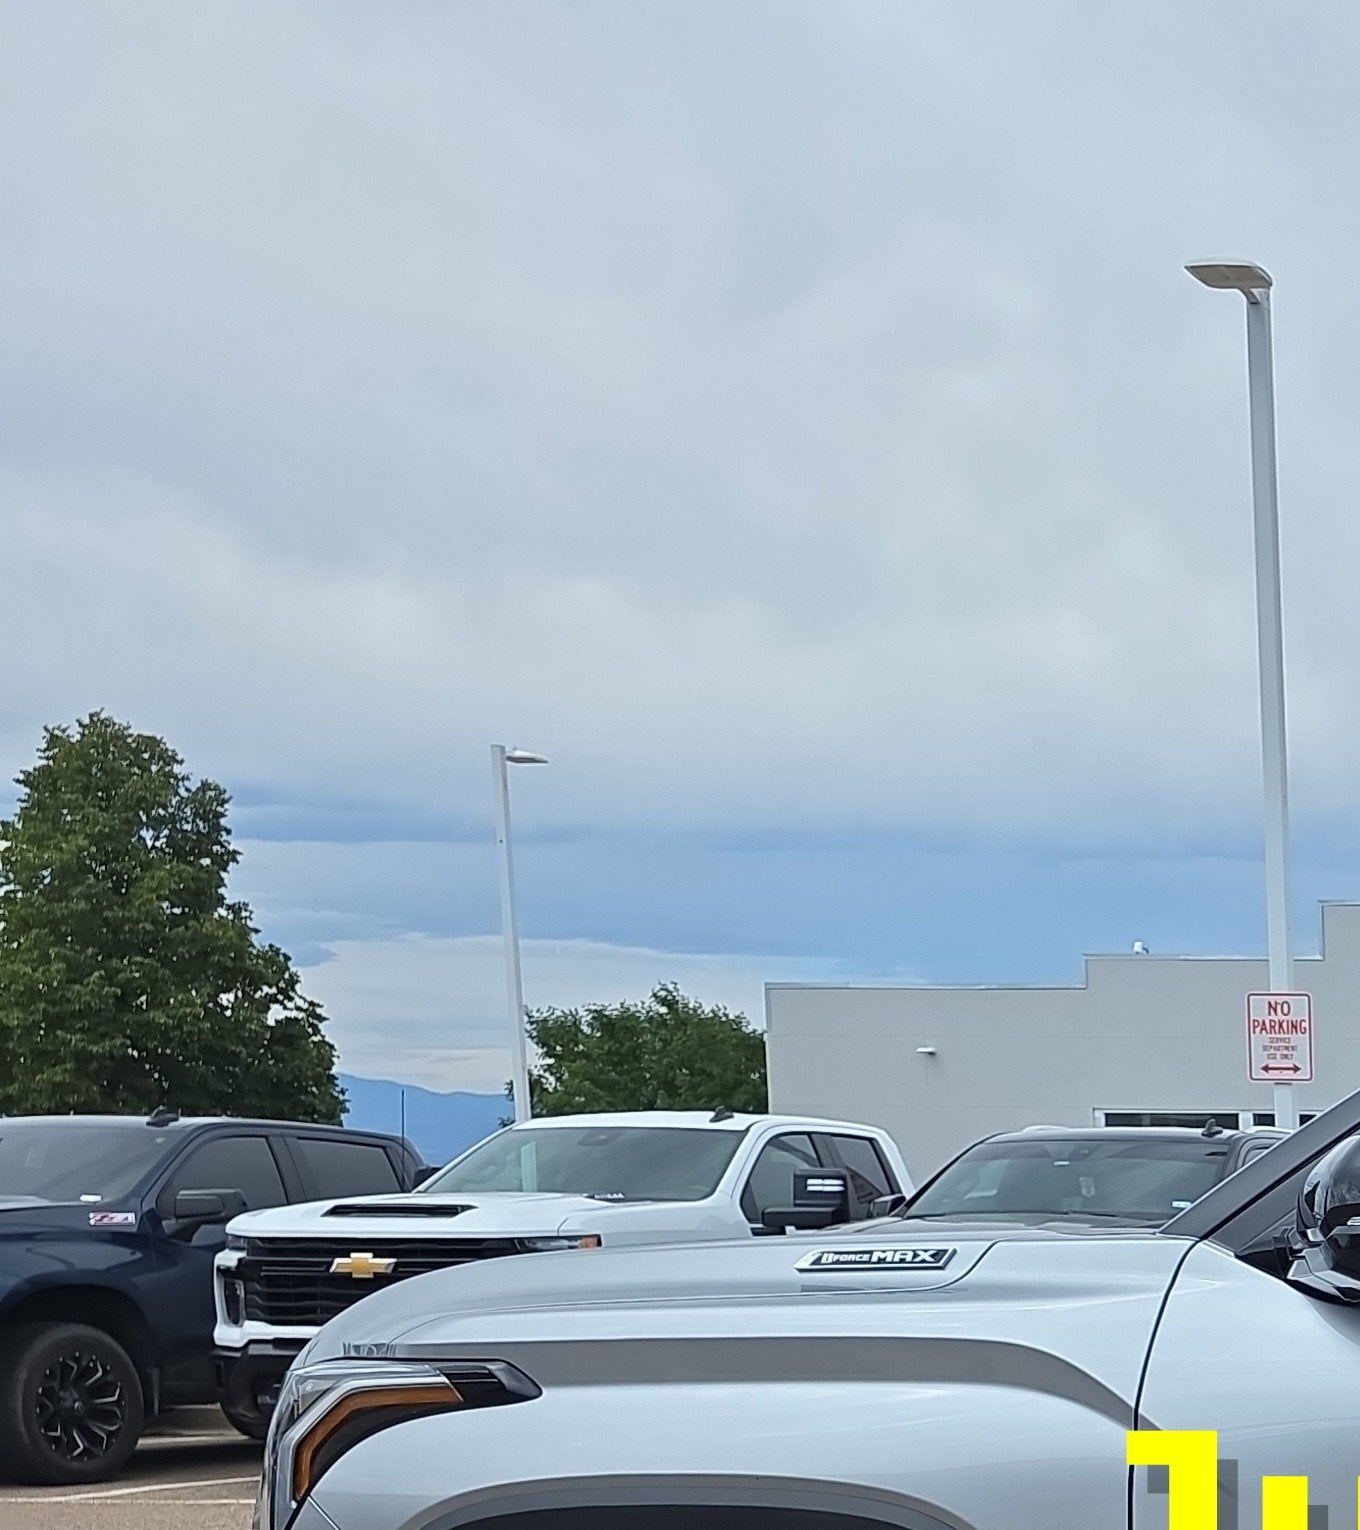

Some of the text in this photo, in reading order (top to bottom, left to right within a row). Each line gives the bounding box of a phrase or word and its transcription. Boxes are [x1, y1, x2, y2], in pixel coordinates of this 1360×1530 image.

[1267, 1000, 1291, 1017] NO
[1252, 1019, 1307, 1035] PARKING
[870, 1250, 938, 1263] MAX
